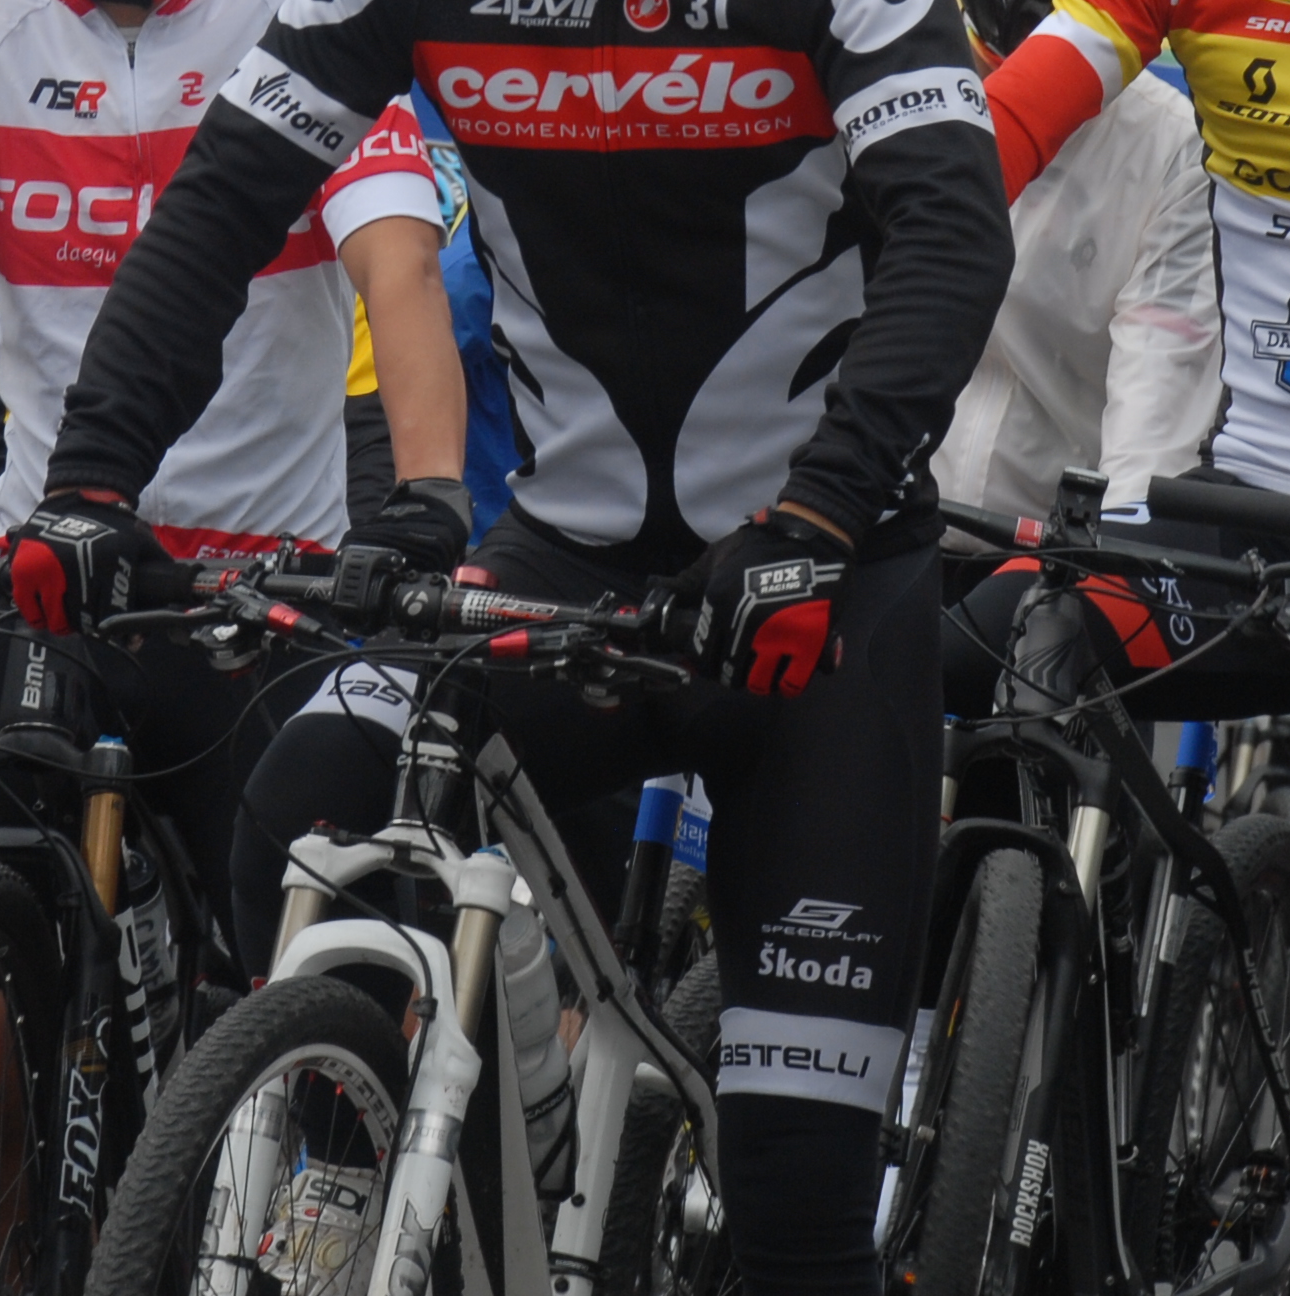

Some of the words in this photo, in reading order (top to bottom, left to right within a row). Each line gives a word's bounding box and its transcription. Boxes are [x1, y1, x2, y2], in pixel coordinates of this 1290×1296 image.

[250, 70, 346, 152] Vittoria
[437, 52, 796, 116] cervélo
[56, 240, 117, 268] daegu
[758, 564, 802, 586] FOX
[21, 641, 47, 710] BMC
[761, 923, 884, 945] SPEEDPLAY
[758, 940, 873, 991] Škoda
[1009, 1138, 1050, 1248] ROCKSHOX
